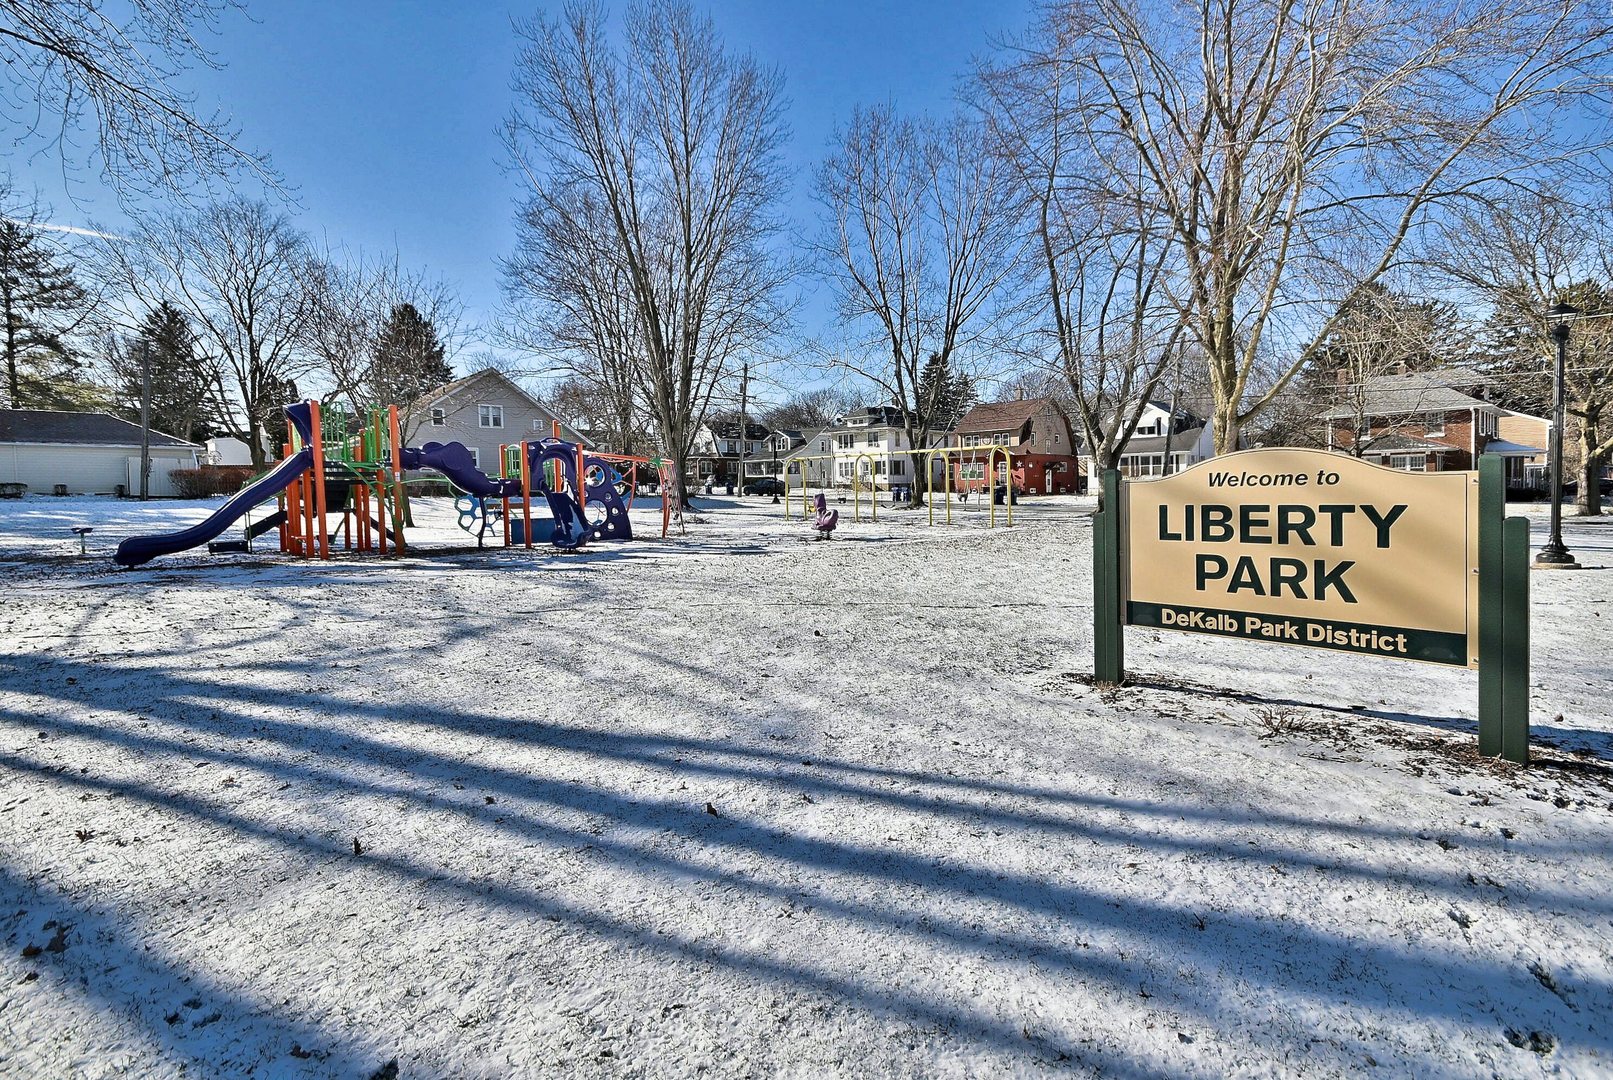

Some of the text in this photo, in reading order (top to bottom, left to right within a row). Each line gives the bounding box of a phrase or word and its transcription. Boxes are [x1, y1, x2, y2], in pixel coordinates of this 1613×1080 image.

[1208, 469, 1340, 487] Welcome to
[1158, 504, 1408, 548] LIBERTY
[1195, 553, 1359, 604] PARK
[1161, 608, 1407, 652] DeKalb Park District
